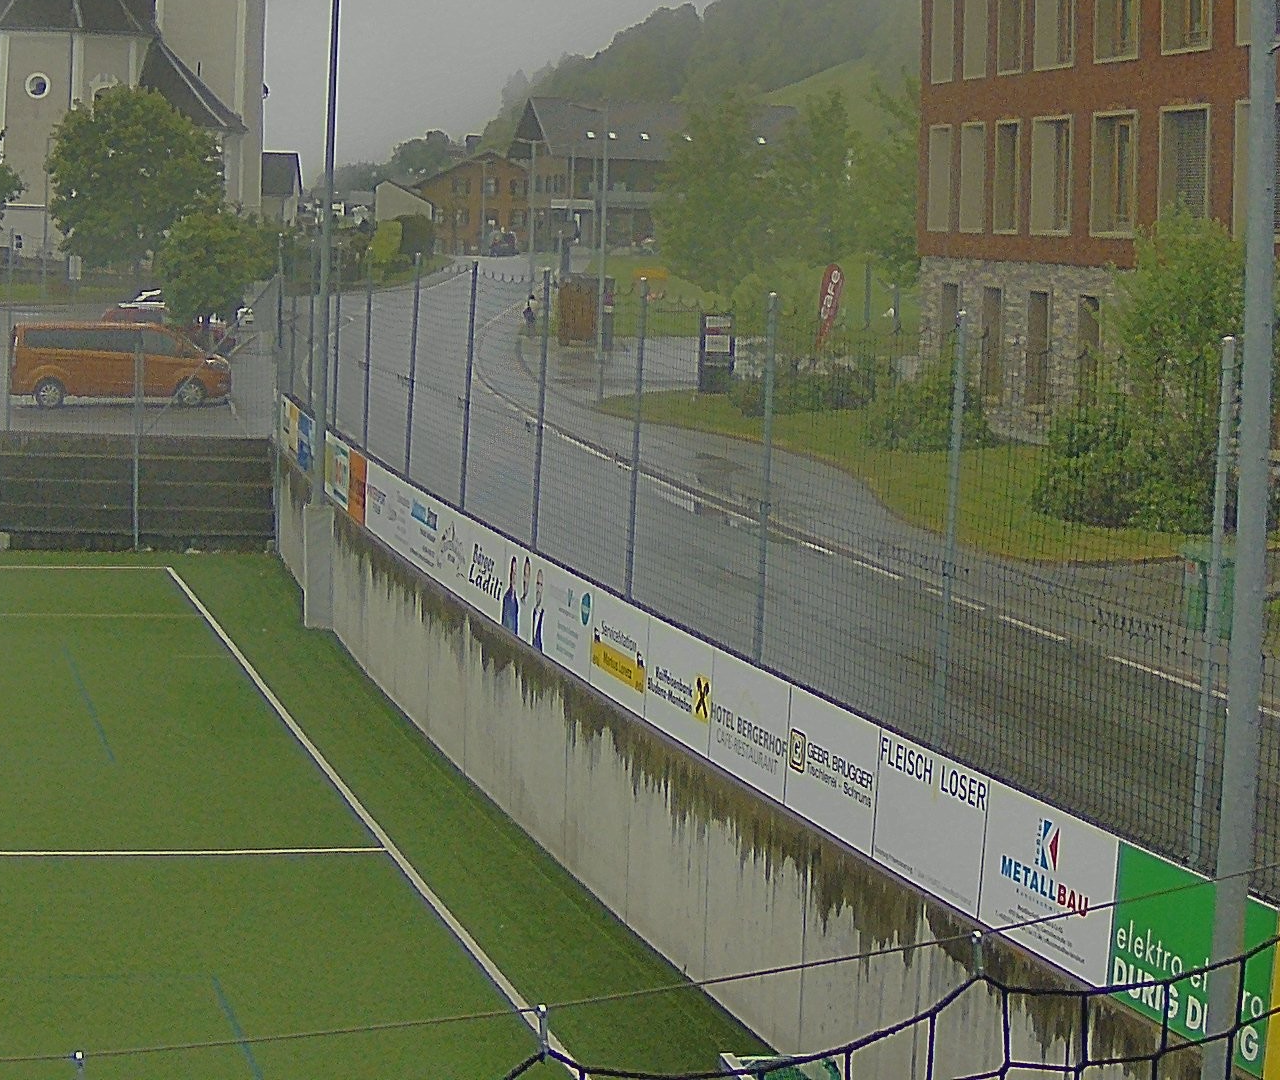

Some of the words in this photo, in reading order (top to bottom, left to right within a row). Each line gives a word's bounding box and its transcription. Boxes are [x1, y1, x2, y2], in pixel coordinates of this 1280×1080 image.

[711, 702, 735, 731] HOTEL
[737, 716, 788, 758] BERGERHOF
[807, 742, 831, 768] GEBR.
[880, 736, 933, 785] FLEISCH
[940, 765, 987, 812] LOSER
[1001, 854, 1089, 918] METALLBAU
[1116, 919, 1183, 978] elektro
